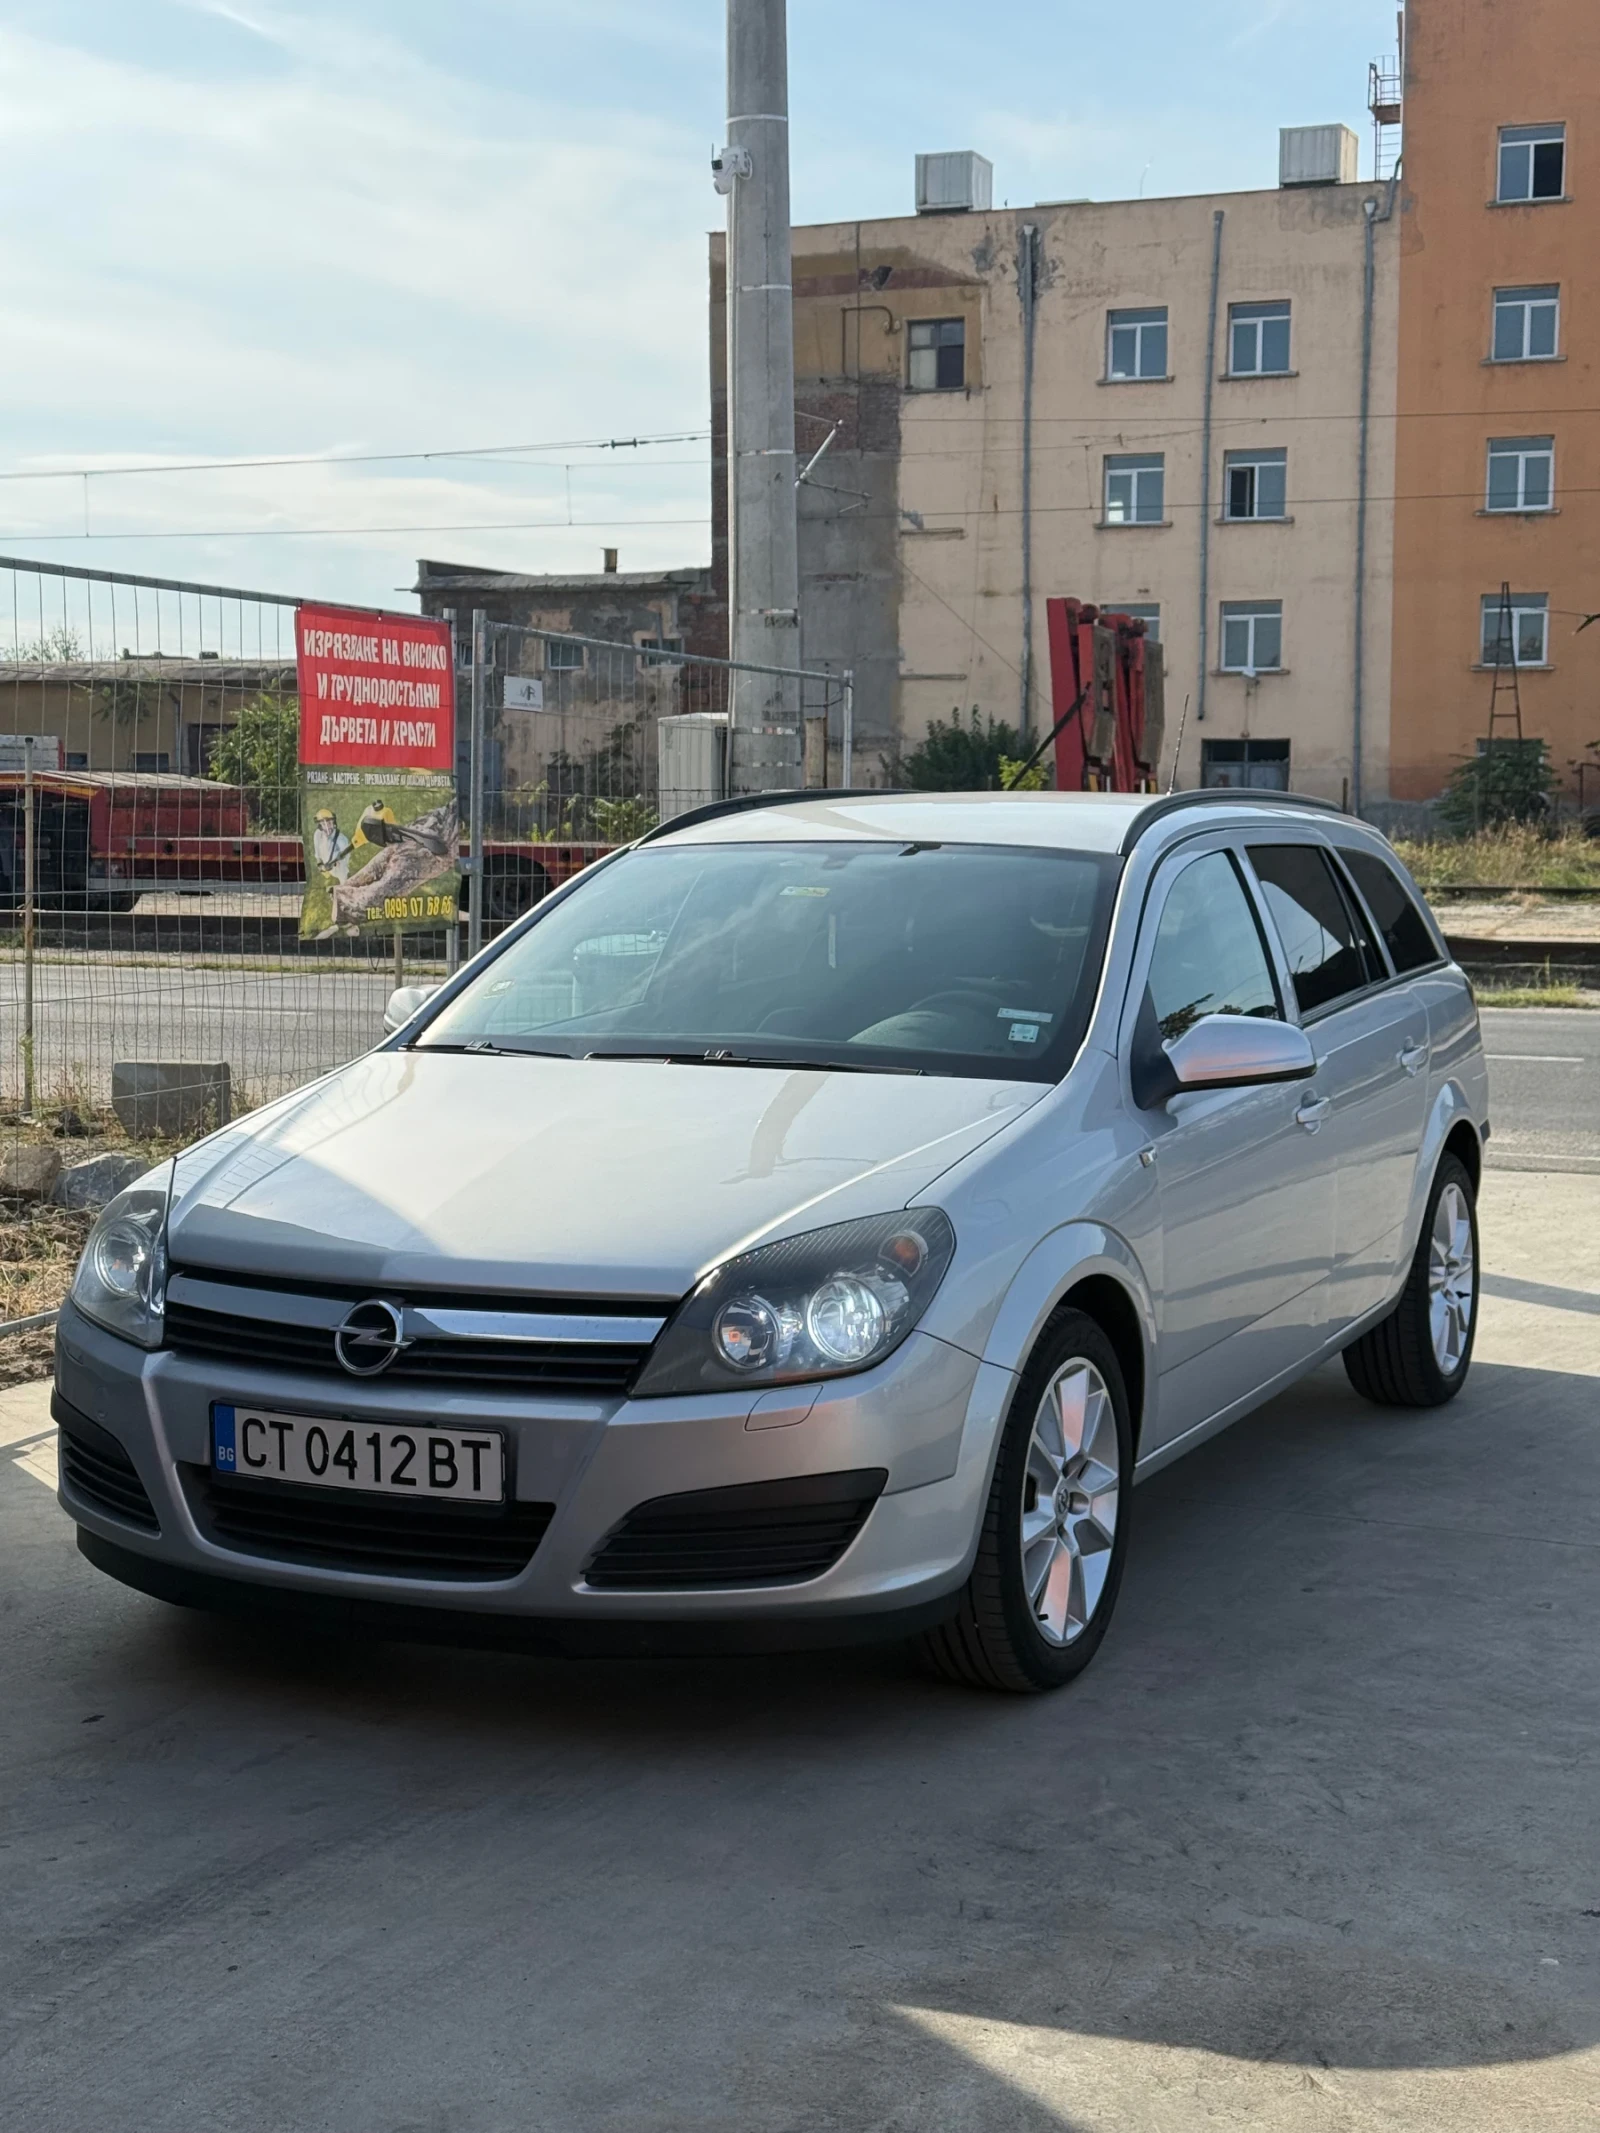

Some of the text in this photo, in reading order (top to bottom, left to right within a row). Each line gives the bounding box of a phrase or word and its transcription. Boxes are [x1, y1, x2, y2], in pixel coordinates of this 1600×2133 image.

[303, 629, 447, 671] ИЗРЯЗВАНЕ НА ВИСОКО
[316, 673, 440, 708] И ТРУДНОДОСТЪПНИ
[319, 715, 437, 748] ДЪРВЕТА И ХРАСТИ
[384, 897, 408, 919] 0896
[410, 896, 423, 917] 07
[426, 896, 440, 916] 68
[218, 1446, 234, 1461] BG
[242, 1418, 491, 1491] CT 0412 BT
